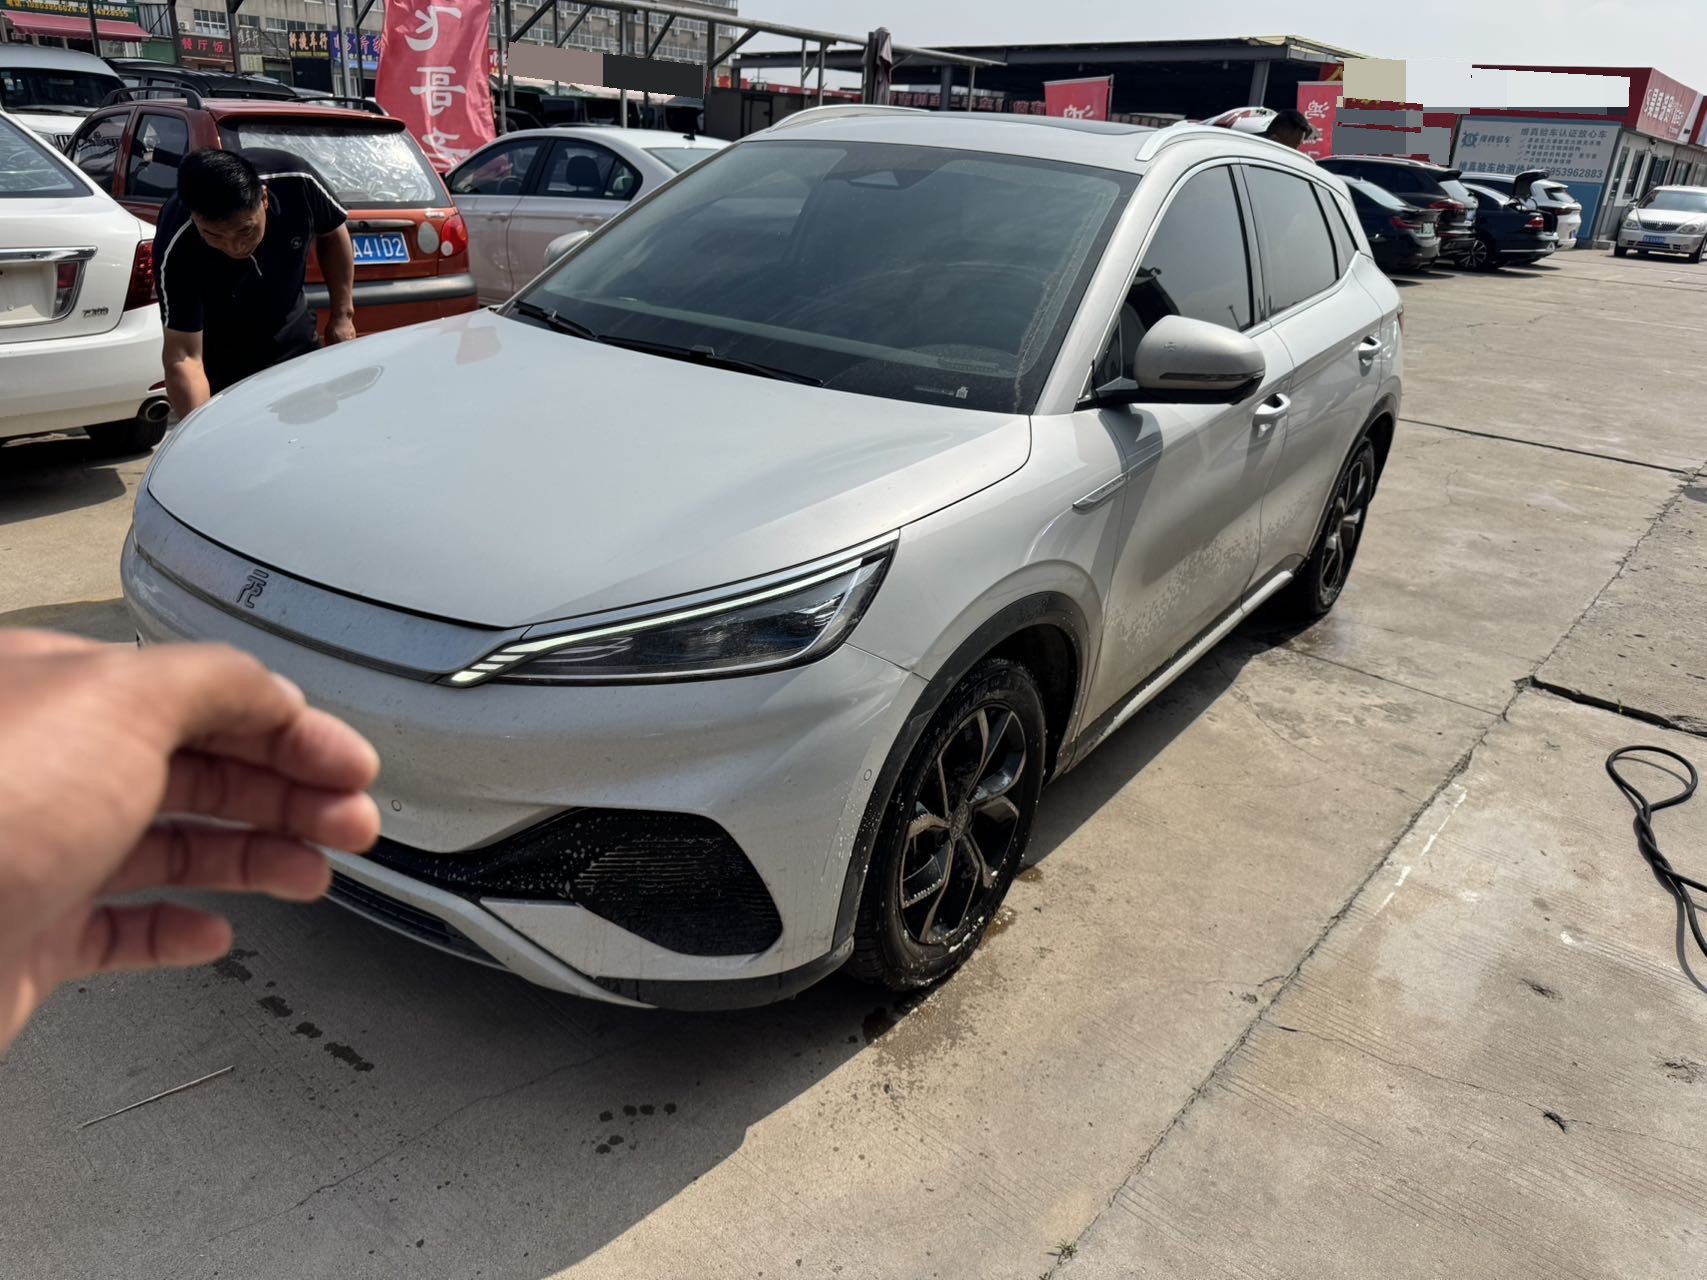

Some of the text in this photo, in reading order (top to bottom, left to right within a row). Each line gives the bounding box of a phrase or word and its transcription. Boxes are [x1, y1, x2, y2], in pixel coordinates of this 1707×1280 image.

[182, 37, 232, 54] 餐厅饭
[1540, 165, 1604, 178] 953962883
